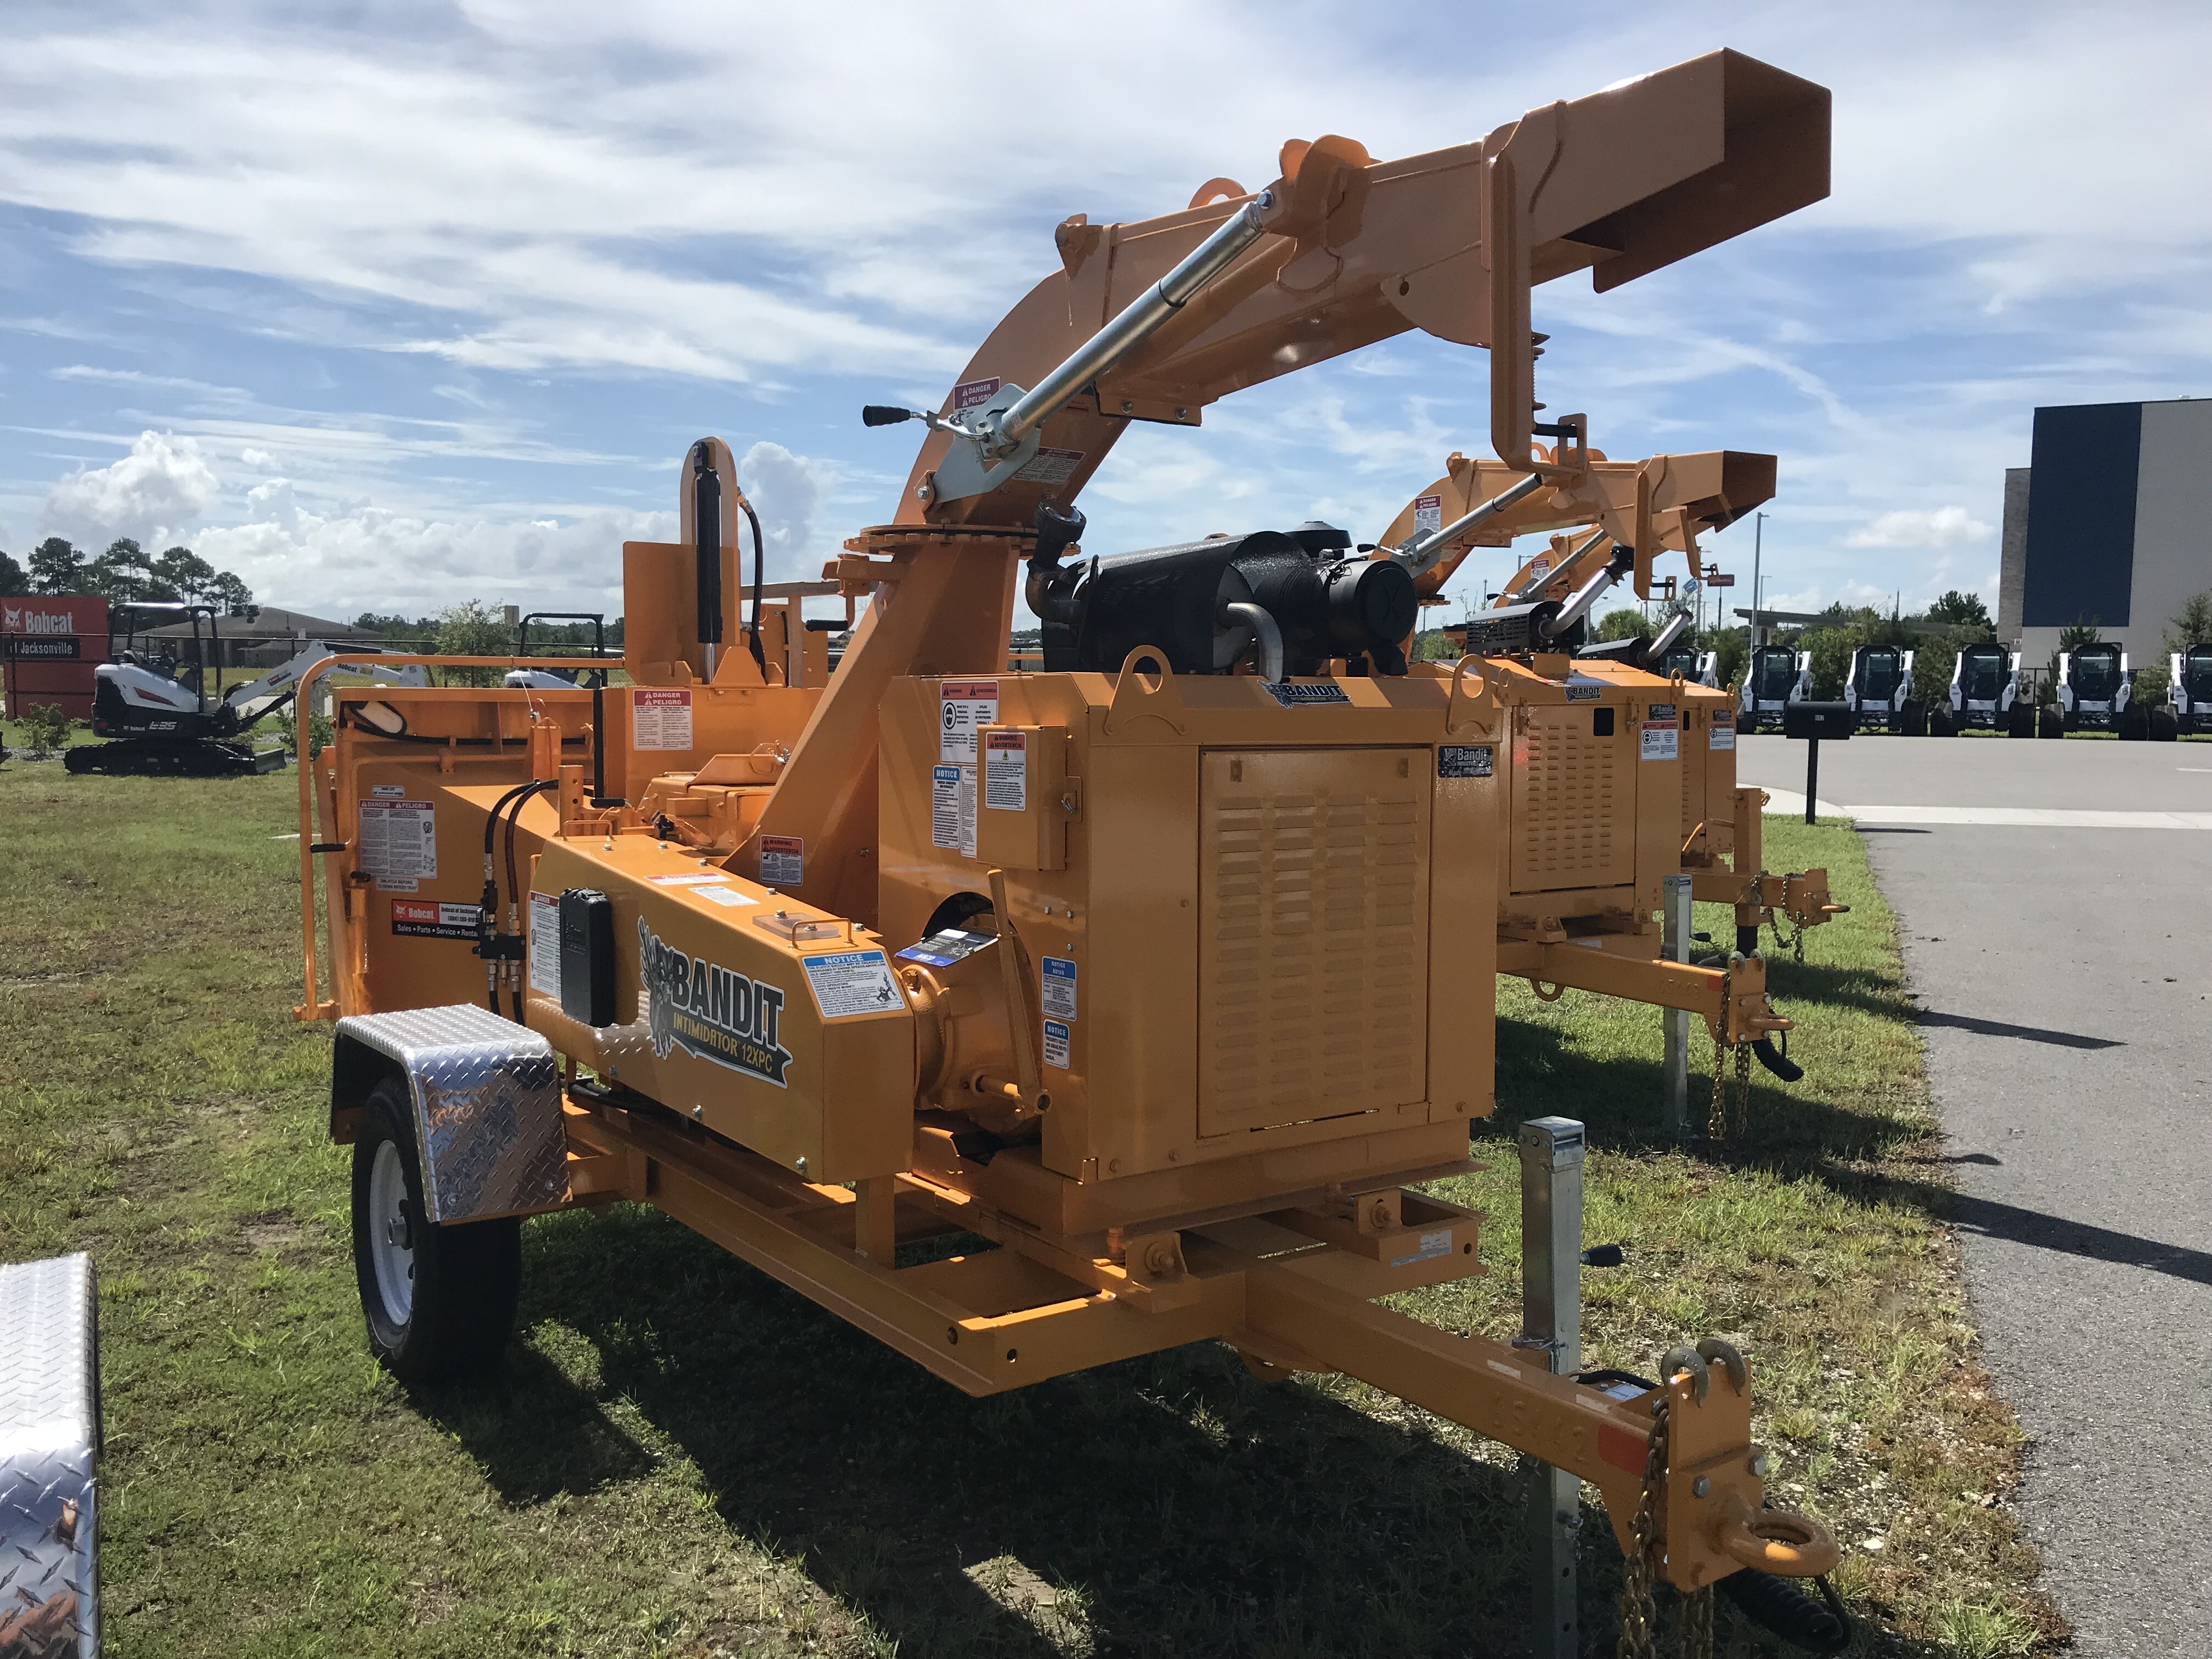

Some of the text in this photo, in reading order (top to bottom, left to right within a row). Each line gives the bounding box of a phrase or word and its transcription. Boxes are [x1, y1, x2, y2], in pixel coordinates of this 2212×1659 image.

[968, 384, 991, 394] DANGER
[968, 393, 991, 404] PELIGRO
[25, 611, 74, 633] Bobcat
[21, 642, 72, 654] Jacksonville
[1285, 685, 1344, 696] BANDIT
[1572, 687, 1600, 695] BANDIT
[1457, 748, 1487, 761] Bandit
[936, 770, 957, 778] NOTICE
[408, 908, 434, 919] Bobcat
[397, 924, 411, 932] Sales
[436, 927, 456, 935] Service
[824, 954, 864, 964] NOTICE
[671, 949, 784, 1050] BANDIT
[1047, 1025, 1066, 1036] NOTICE
[673, 1012, 773, 1073] INTIMIDATOR 12XPC
